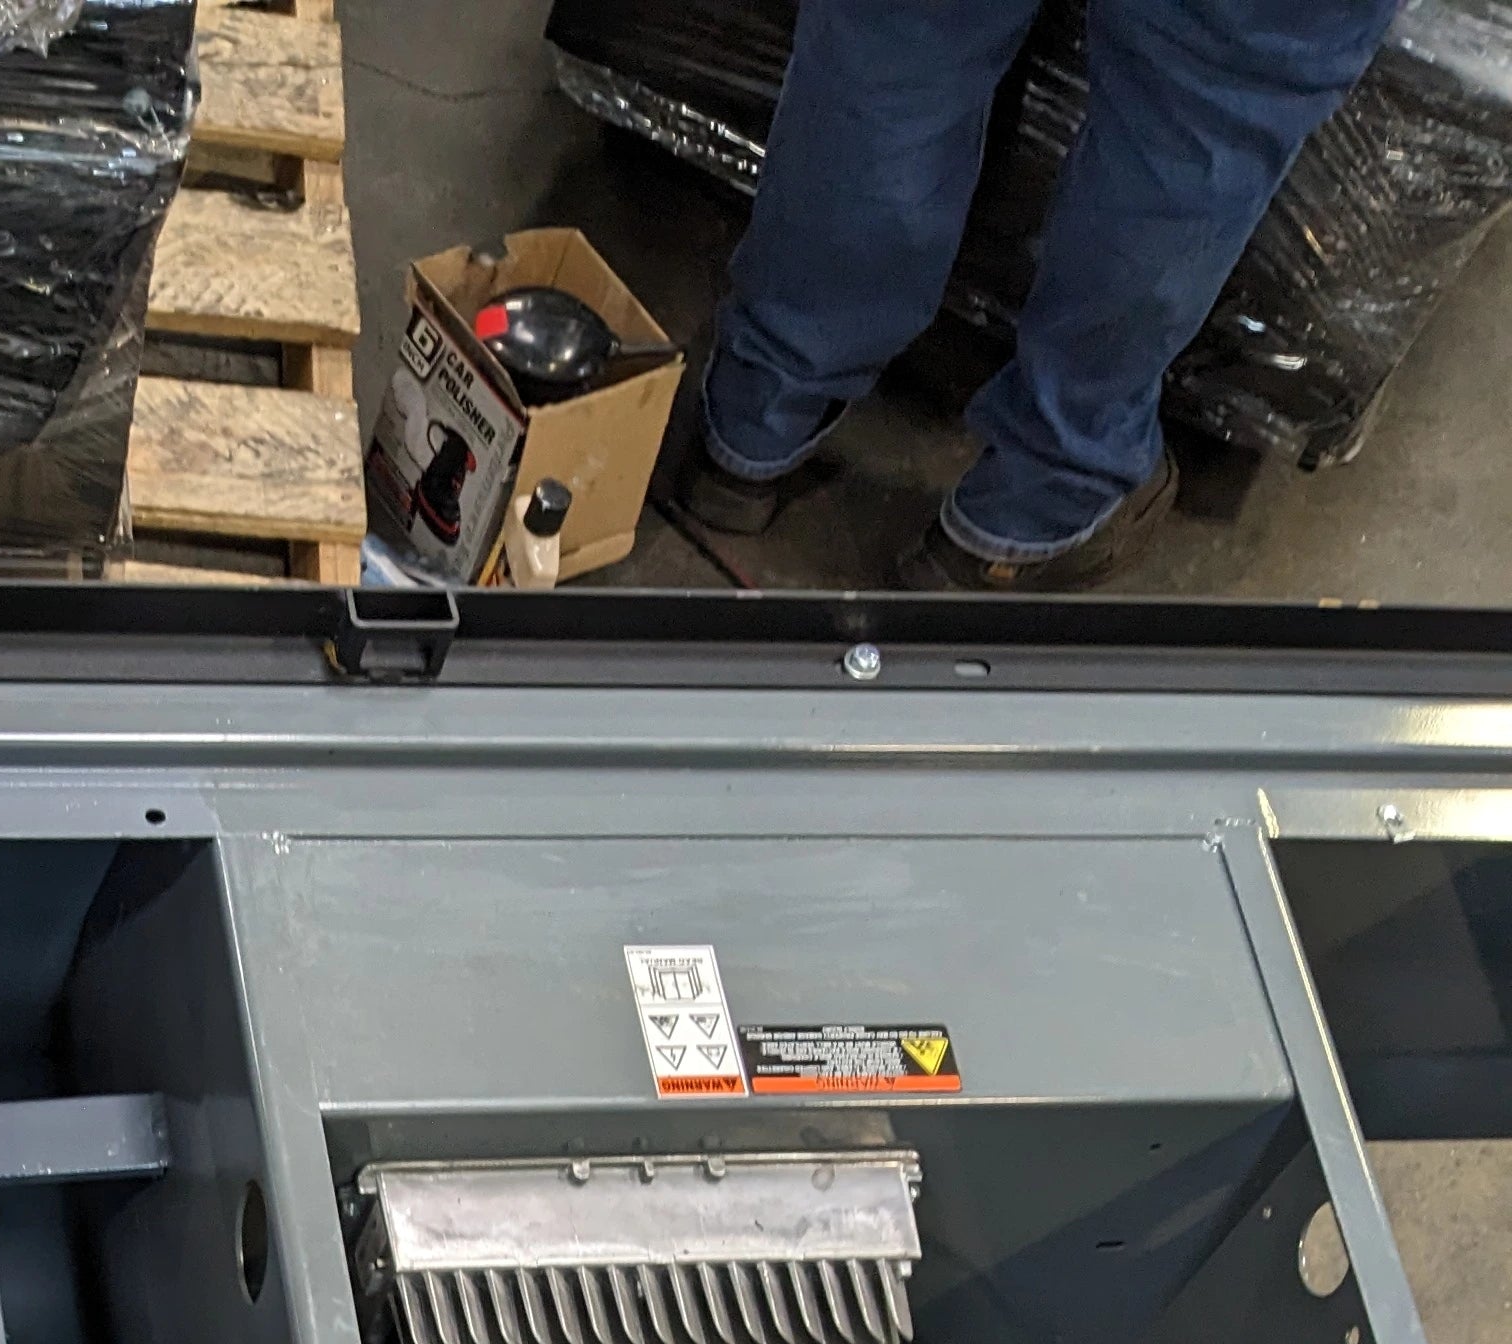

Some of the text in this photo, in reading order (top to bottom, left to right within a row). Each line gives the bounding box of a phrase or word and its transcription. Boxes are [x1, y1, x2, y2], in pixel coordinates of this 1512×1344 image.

[445, 349, 476, 387] CAR
[439, 370, 496, 446] POLISHER
[660, 1078, 724, 1091] WARNING
